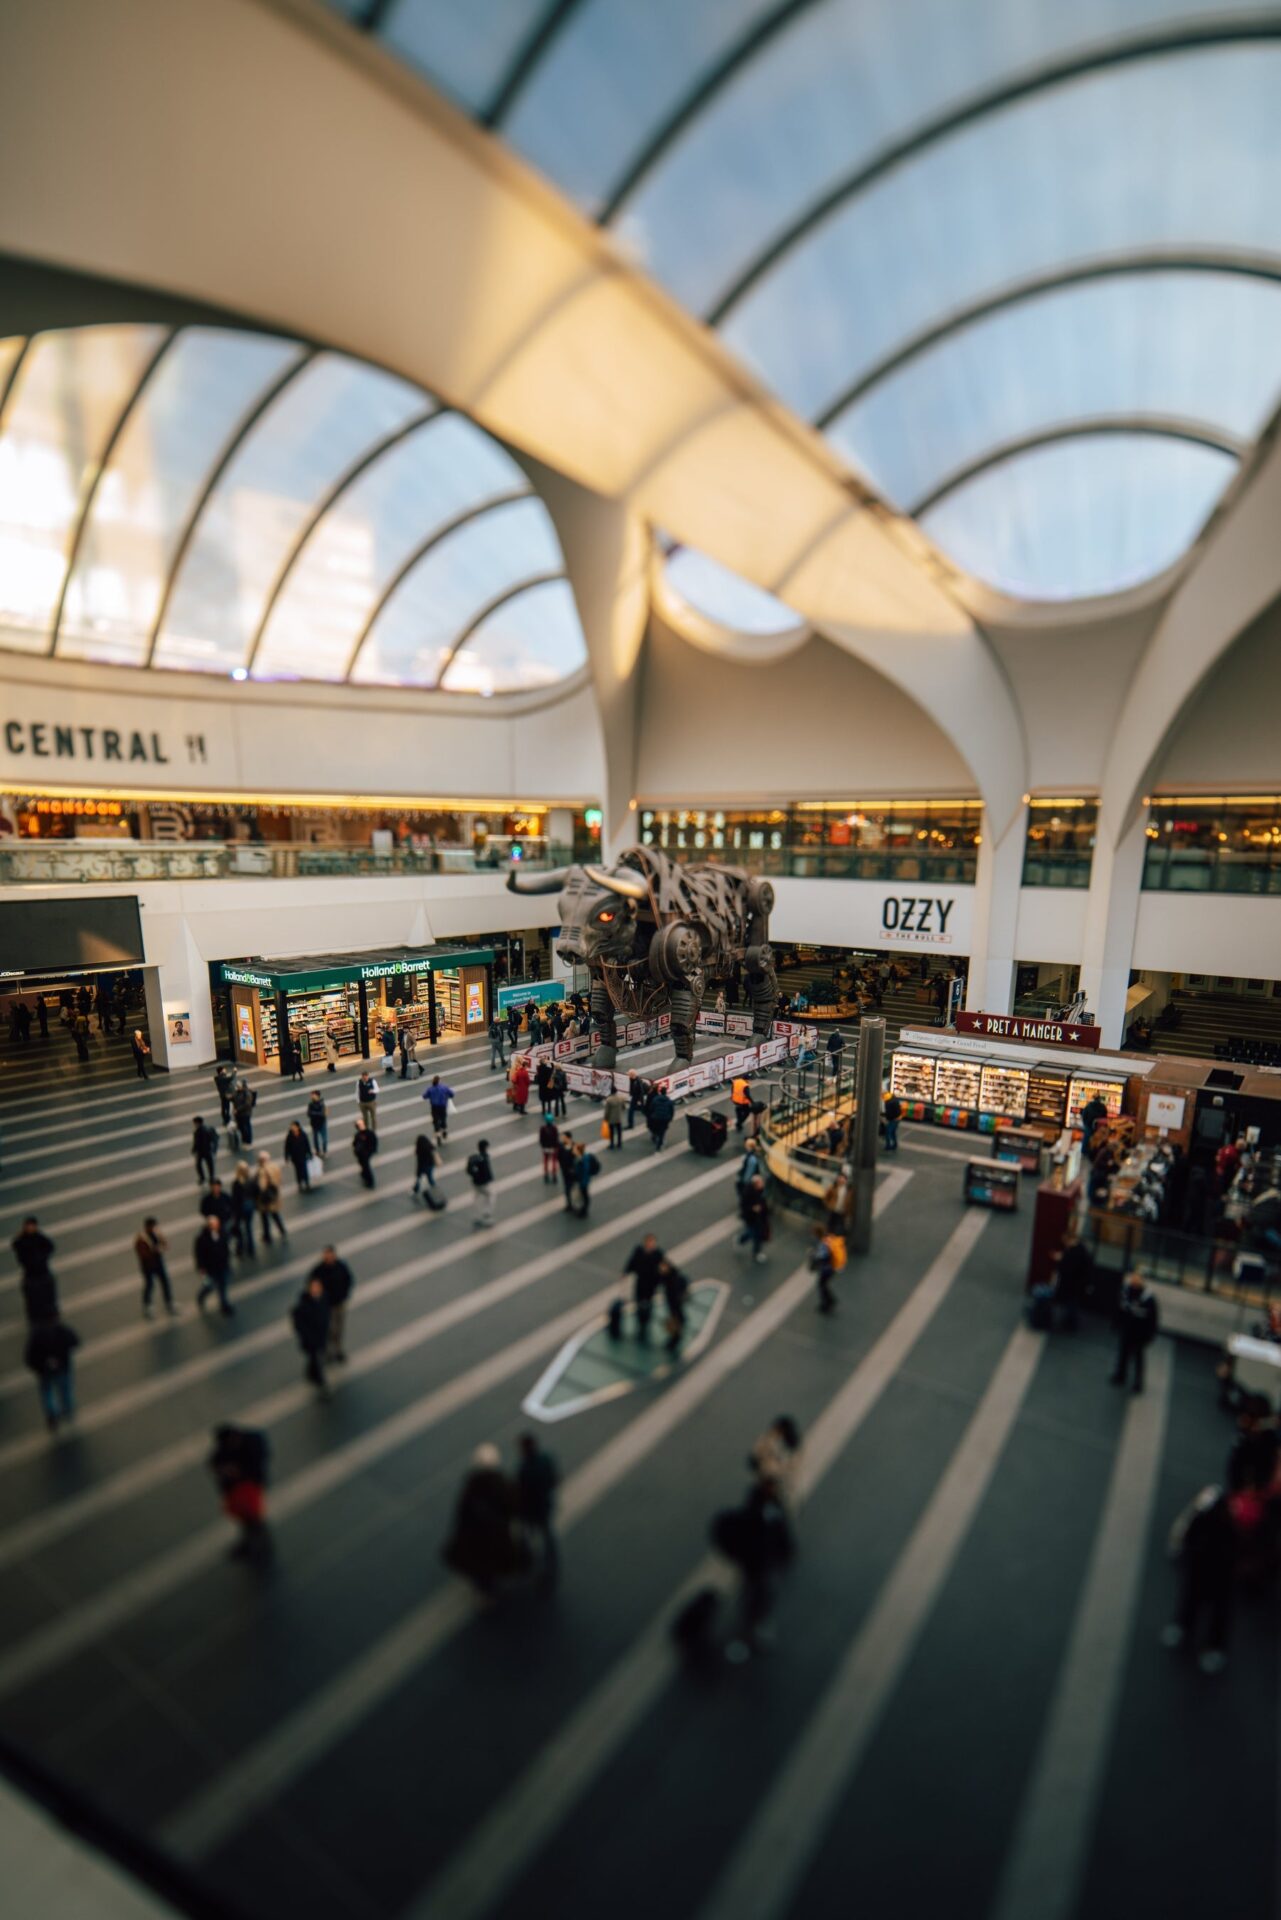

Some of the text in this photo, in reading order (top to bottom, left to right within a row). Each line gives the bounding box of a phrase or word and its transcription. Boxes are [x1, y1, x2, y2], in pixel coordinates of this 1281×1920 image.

[5, 720, 169, 764] CENTRAL
[882, 897, 955, 934] OZZY
[361, 963, 396, 979] Holland
[401, 959, 431, 973] Barrett
[987, 1018, 1063, 1041] PRET A MANGER
